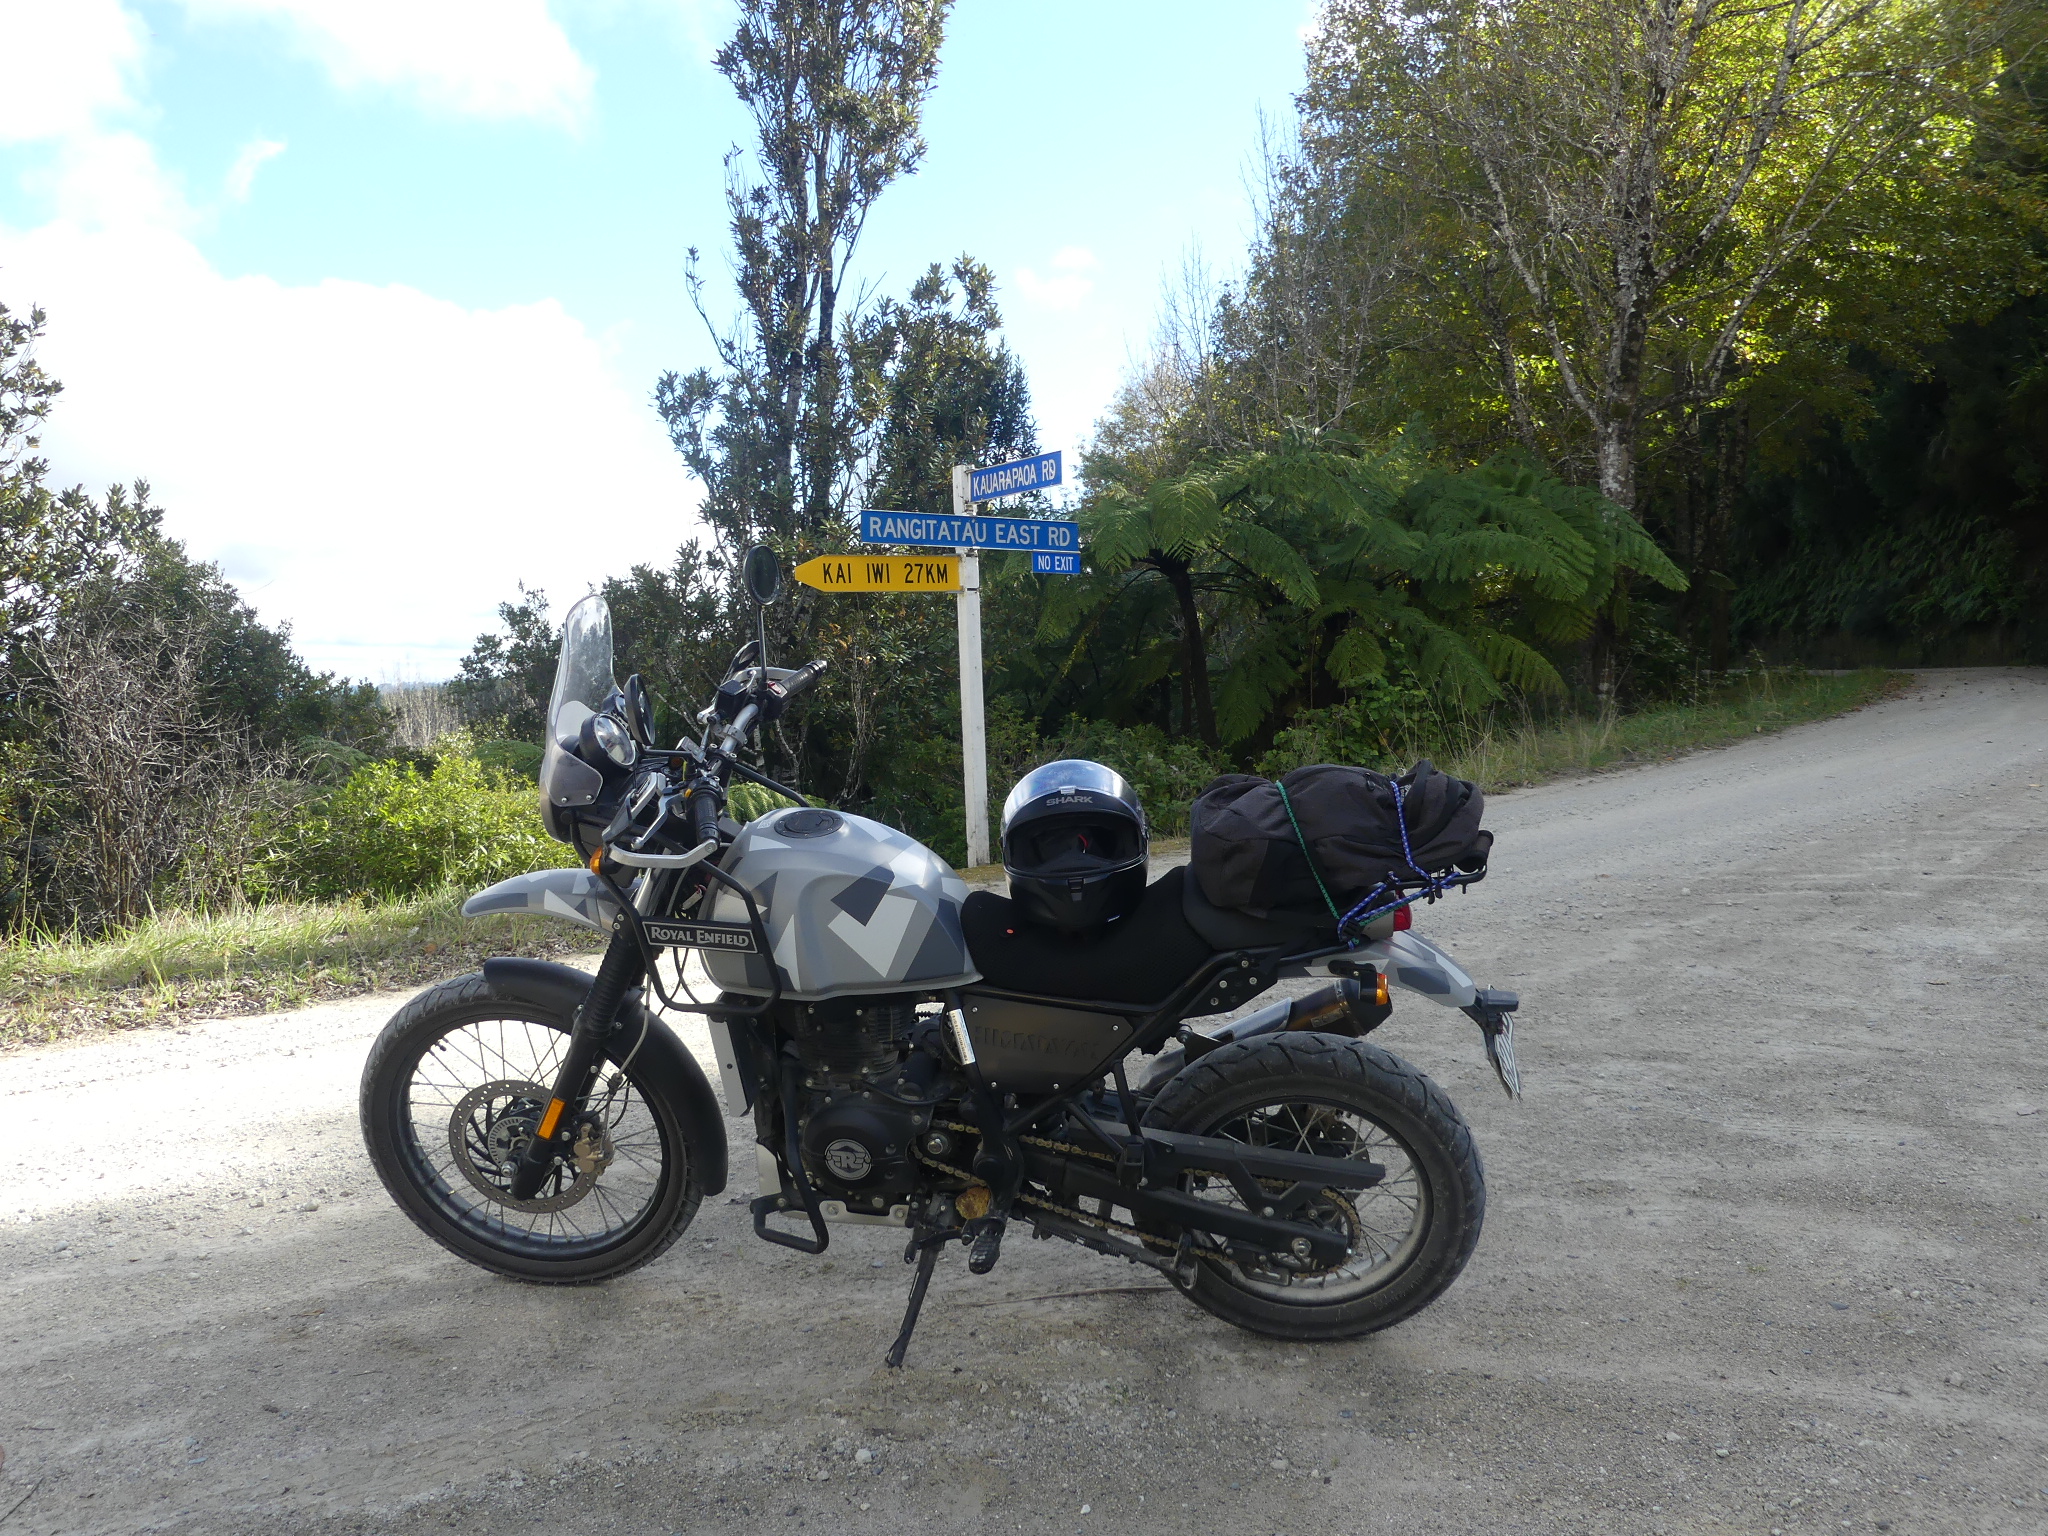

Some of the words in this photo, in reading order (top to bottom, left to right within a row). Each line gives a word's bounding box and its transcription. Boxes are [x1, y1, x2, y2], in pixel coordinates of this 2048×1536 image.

[973, 464, 1037, 497] KAUARAPAOA
[1041, 458, 1056, 481] RD
[869, 516, 987, 544] RANGITATAU
[995, 523, 1040, 546] EAST
[1048, 526, 1071, 547] RD
[823, 563, 852, 584] KAI
[867, 563, 891, 584] IWI
[904, 563, 948, 584] 27KM
[1037, 555, 1051, 571] NO
[1054, 556, 1074, 572] EXIT
[1046, 795, 1093, 806] SHARK
[651, 926, 694, 942] ROYAL
[696, 929, 750, 947] ENFIELD
